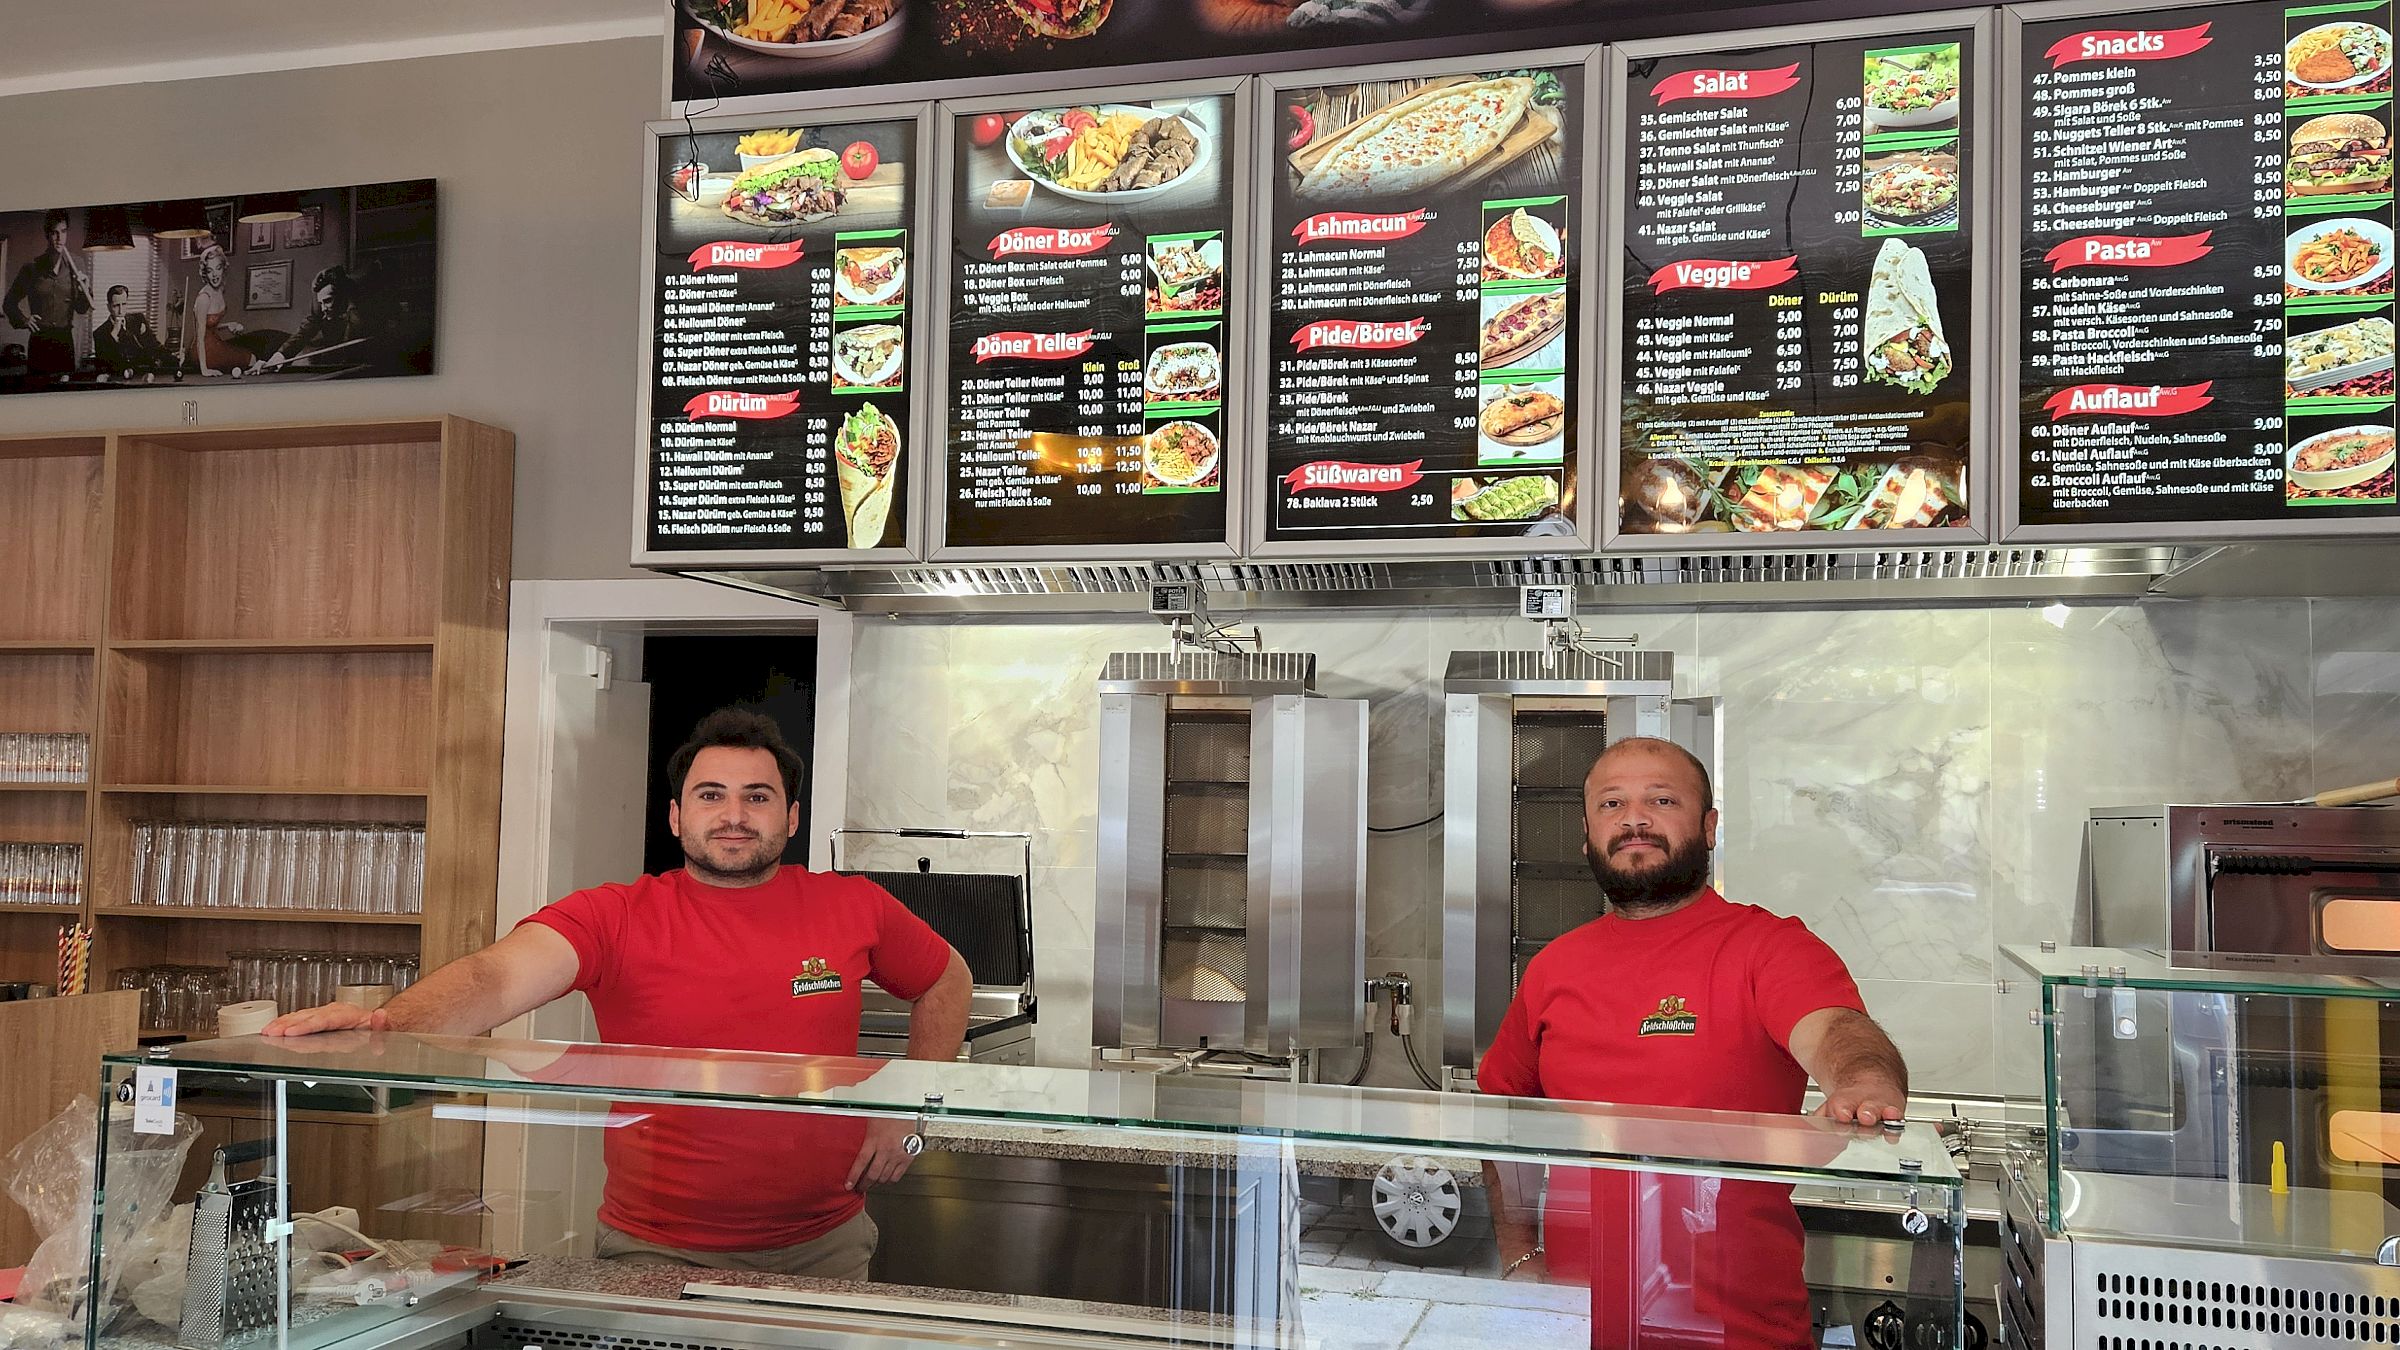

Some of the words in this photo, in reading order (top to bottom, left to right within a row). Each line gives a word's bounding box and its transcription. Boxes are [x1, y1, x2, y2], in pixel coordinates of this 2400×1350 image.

[2082, 31, 2164, 56] Snacks
[2255, 54, 2281, 67] 3,50
[1694, 72, 1747, 93] Salat
[2033, 74, 2052, 85] 47.
[2054, 68, 2107, 83] Pommes
[2106, 67, 2135, 79] klein
[2254, 70, 2281, 84] 4,50
[2033, 90, 2052, 101] 48.
[2054, 88, 2107, 102] Pommes
[2106, 82, 2135, 98] groß
[1836, 97, 1861, 110] 6,00
[1641, 114, 1657, 125] 35.
[1659, 110, 1721, 124] Gemischter
[1720, 107, 1747, 119] Salat
[2054, 156, 2070, 167] mit
[2071, 154, 2097, 167] Salat,
[2097, 152, 2139, 164] Pommes
[2141, 151, 2160, 162] und
[2161, 148, 2186, 160] Soße
[2255, 155, 2281, 168] 7,00
[2033, 171, 2051, 183] 52.
[2054, 165, 2121, 181] Hamburger
[1836, 181, 1860, 193] 7,50
[1639, 195, 1655, 206] 40.
[1657, 193, 1694, 208] Veggie
[1696, 191, 1723, 203] Salat
[1306, 217, 1406, 238] Lahmacun
[1000, 232, 1053, 252] Döner
[1056, 229, 1093, 249] Box
[1457, 241, 1479, 254] 6,50
[710, 245, 764, 264] Döner
[1282, 252, 1297, 263] 27.
[1299, 251, 1348, 262] Lahmacun
[1350, 247, 1385, 259] Normal
[2086, 241, 2150, 260] Pasta
[964, 264, 978, 274] 17.
[977, 263, 1006, 274] Döner
[1008, 262, 1025, 272] Box
[1026, 263, 1038, 271] mit
[1076, 259, 1107, 267] Pommes
[1121, 254, 1141, 266] 6,00
[666, 276, 679, 285] 01.
[680, 275, 706, 285] Döner
[707, 273, 737, 283] Normal
[811, 268, 830, 280] 6,00
[1121, 269, 1141, 280] 6,00
[1457, 273, 1478, 285] 8,00
[811, 283, 830, 294] 7,00
[964, 279, 977, 289] 18.
[979, 278, 1006, 289] Döner
[1008, 277, 1024, 287] Box
[1282, 284, 1296, 294] 29.
[1298, 282, 1347, 293] Lahmacun
[1349, 282, 1362, 291] mit
[1363, 279, 1411, 290] Dönerfleisch
[665, 290, 680, 300] 02.
[679, 289, 705, 299] Döner
[1769, 295, 1803, 306] Döner
[1820, 292, 1858, 303] Dürüm
[2054, 293, 2070, 302] mit
[2071, 289, 2127, 303] Sahne-Soße
[2129, 288, 2147, 298] und
[2149, 285, 2224, 297] Vorderschinken
[1637, 319, 1654, 329] 42.
[1653, 316, 1692, 330] Veggie
[1694, 314, 1733, 326] Normal
[1778, 311, 1802, 323] 5,00
[1833, 308, 1858, 320] 6,00
[2054, 315, 2070, 327] mit
[2071, 313, 2104, 326] versch.
[2105, 312, 2159, 326] Käsesorten
[2159, 311, 2178, 321] und
[2180, 309, 2233, 320] Sahnesoße
[811, 327, 829, 338] 7,50
[2254, 319, 2282, 332] 7,50
[664, 333, 679, 343] 05.
[678, 333, 703, 344] Super
[702, 332, 730, 342] Döner
[761, 331, 784, 339] Fleisch
[1310, 321, 1418, 345] Pide/Börek
[977, 335, 1031, 355] Döner
[1034, 333, 1087, 352] Teller
[1637, 351, 1653, 362] 44.
[1655, 349, 1691, 363] Veggie
[1694, 351, 1708, 359] mit
[1083, 362, 1104, 372] Klein
[1118, 360, 1139, 370] Groß
[962, 380, 975, 390] 20.
[977, 379, 1004, 389] Döner
[1005, 377, 1030, 388] Teller
[1031, 376, 1064, 387] Normal
[1084, 374, 1103, 385] 9,00
[1118, 372, 1142, 383] 10,00
[709, 393, 768, 412] Dürüm
[2071, 386, 2163, 409] Auflauf
[661, 423, 674, 433] 09.
[675, 423, 706, 433] Dürüm
[705, 421, 736, 432] Normal
[808, 419, 826, 430] 7,00
[1279, 424, 1294, 434] 34.
[1296, 421, 1348, 435] Pide/Börek
[1350, 421, 1377, 432] Nazar
[1454, 417, 1476, 429] 9,00
[2254, 417, 2282, 430] 9,00
[1296, 433, 1311, 443] mit
[1309, 431, 1371, 443] Knoblauchwurst
[1373, 432, 1388, 441] und
[1389, 431, 1425, 440] Zwiebeln
[2032, 426, 2050, 437] 60.
[2053, 425, 2089, 436] Döner
[2053, 435, 2069, 447] mit
[2070, 436, 2133, 449] Dönerfleisch,
[2134, 435, 2171, 444] Nudeln,
[2173, 432, 2226, 443] Sahnesoße
[2053, 459, 2093, 474] Gemüse,
[2096, 460, 2147, 471] Sahnesoße
[2150, 459, 2168, 469] und
[2170, 459, 2187, 468] mit
[2186, 459, 2211, 468] Käse
[2213, 456, 2271, 467] überbacken
[1305, 464, 1401, 484] Süßwaren
[659, 481, 672, 491] 13.
[673, 481, 698, 492] Super
[699, 480, 728, 490] Dürüm
[759, 480, 782, 489] Fleisch
[806, 478, 824, 488] 8,50
[1077, 484, 1101, 495] 10,00
[1116, 482, 1141, 494] 11,00
[2053, 485, 2069, 496] mit
[2071, 486, 2111, 498] Broccoli,
[2112, 484, 2154, 496] Gemüse,
[2156, 484, 2208, 494] Sahnesoße
[2210, 483, 2229, 492] und
[2232, 483, 2248, 492] mit
[2250, 480, 2273, 491] Käse
[960, 489, 973, 498] 26.
[975, 486, 1005, 500] Fleisch
[1006, 486, 1031, 499] Teller
[1287, 498, 1302, 508] 78.
[1303, 497, 1340, 508] Baklava
[1343, 497, 1349, 507] 2
[1351, 496, 1377, 507] Stück
[1412, 495, 1433, 506] 2,50
[2053, 495, 2108, 508] überbacken
[658, 524, 670, 534] 16.
[672, 524, 700, 534] Fleisch
[701, 524, 730, 534] Dürüm
[742, 524, 766, 532] Fleisch
[767, 524, 773, 532] &
[804, 522, 823, 533] 9,00
